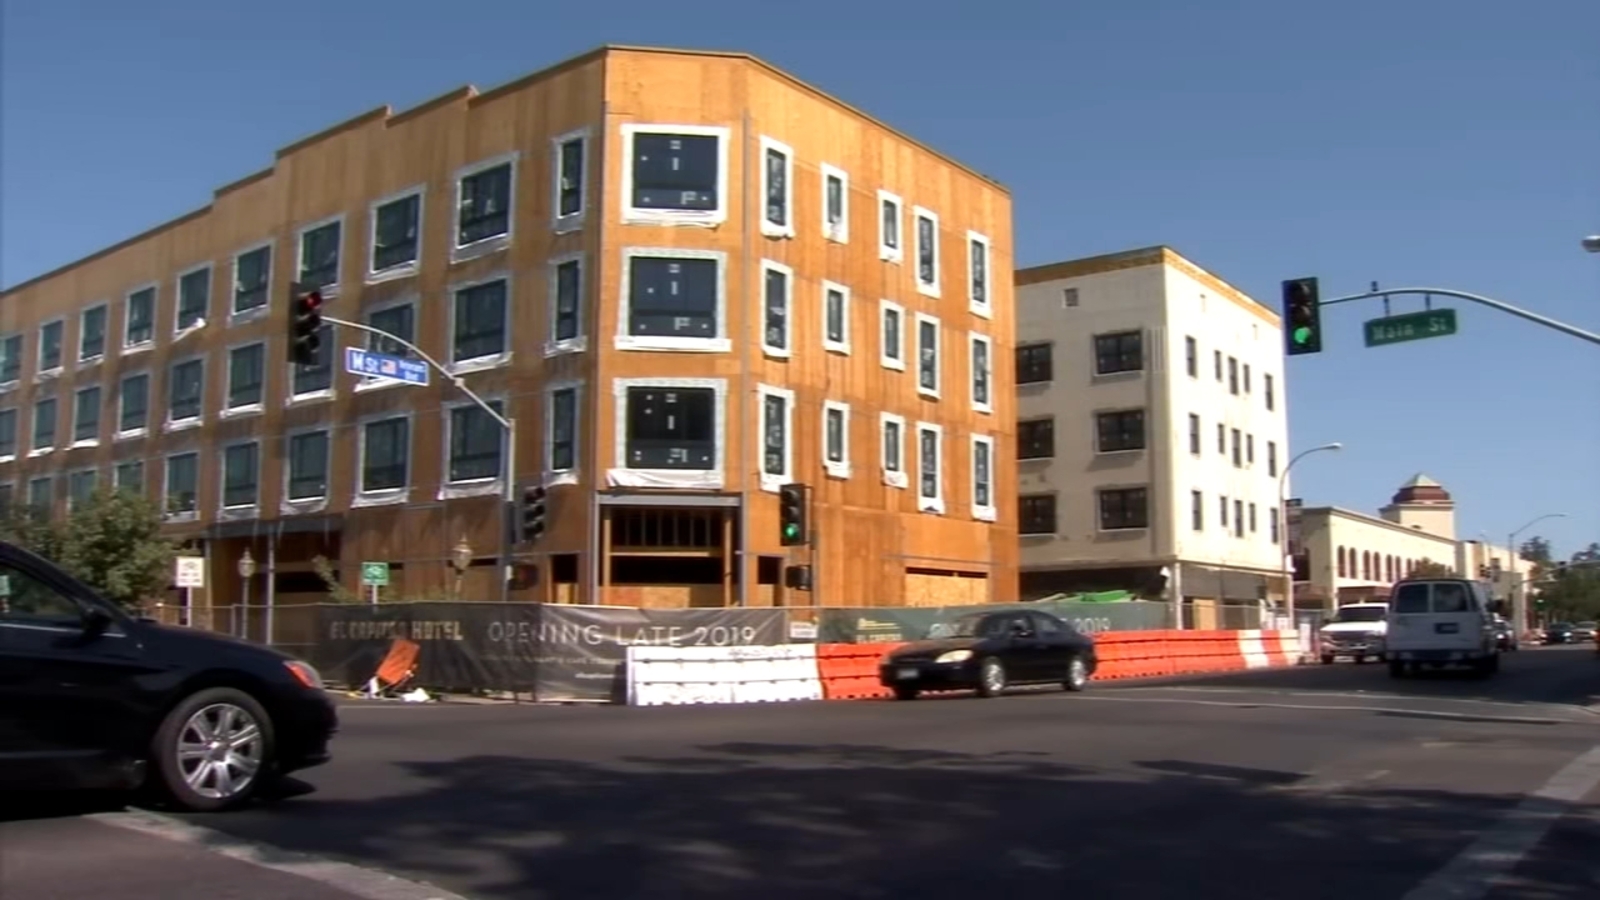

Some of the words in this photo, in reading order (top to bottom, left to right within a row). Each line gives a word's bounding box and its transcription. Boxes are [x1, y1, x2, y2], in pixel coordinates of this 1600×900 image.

[1372, 323, 1415, 340] Main
[1429, 317, 1447, 332] St
[411, 620, 463, 641] HOTEL
[488, 621, 602, 646] OPENING
[616, 625, 681, 646] LATE
[694, 626, 755, 646] 2019
